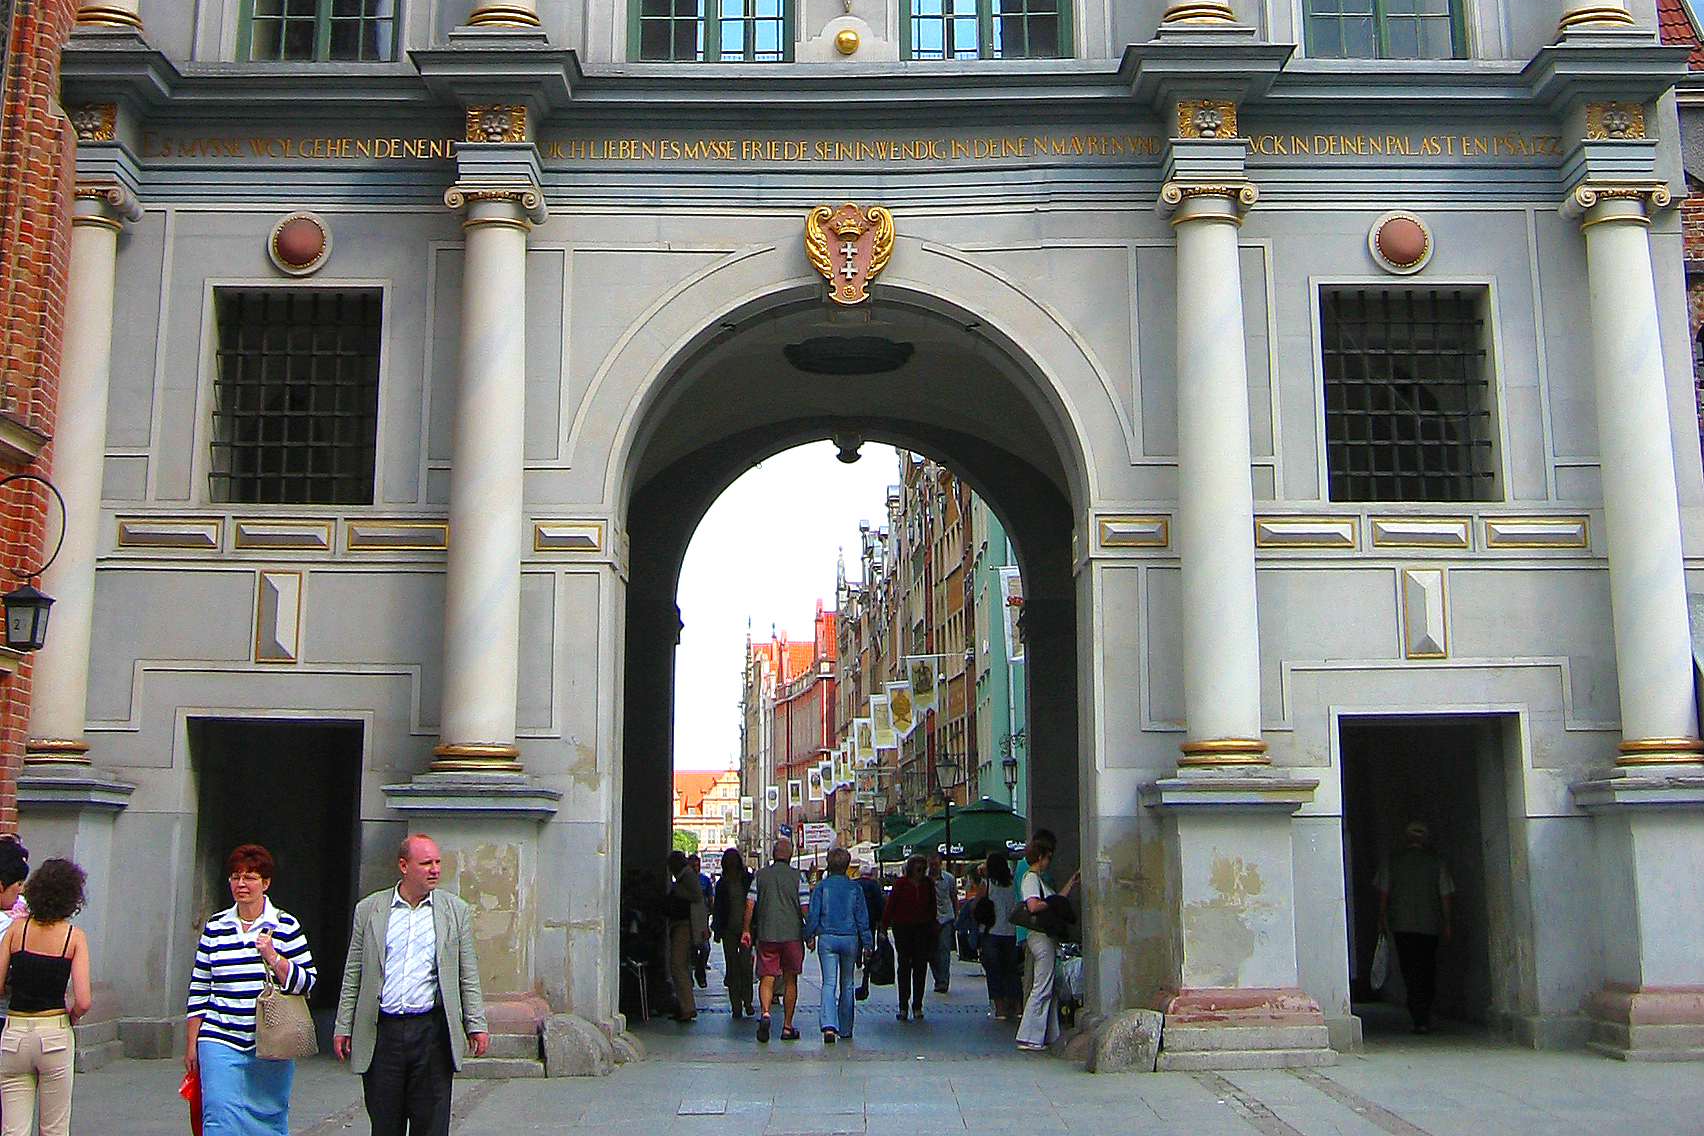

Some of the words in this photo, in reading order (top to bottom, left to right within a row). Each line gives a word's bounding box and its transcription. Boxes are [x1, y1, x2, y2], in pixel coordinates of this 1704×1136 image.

[374, 138, 443, 159] DENEN
[589, 139, 656, 160] LIEBEN
[659, 139, 681, 160] ES
[741, 140, 812, 161] FRIEDE
[950, 138, 970, 160] IN
[974, 135, 1049, 159] DEINEN
[1246, 135, 1288, 156] VCK
[1290, 135, 1310, 156] IN
[1313, 135, 1383, 156] DEINEN
